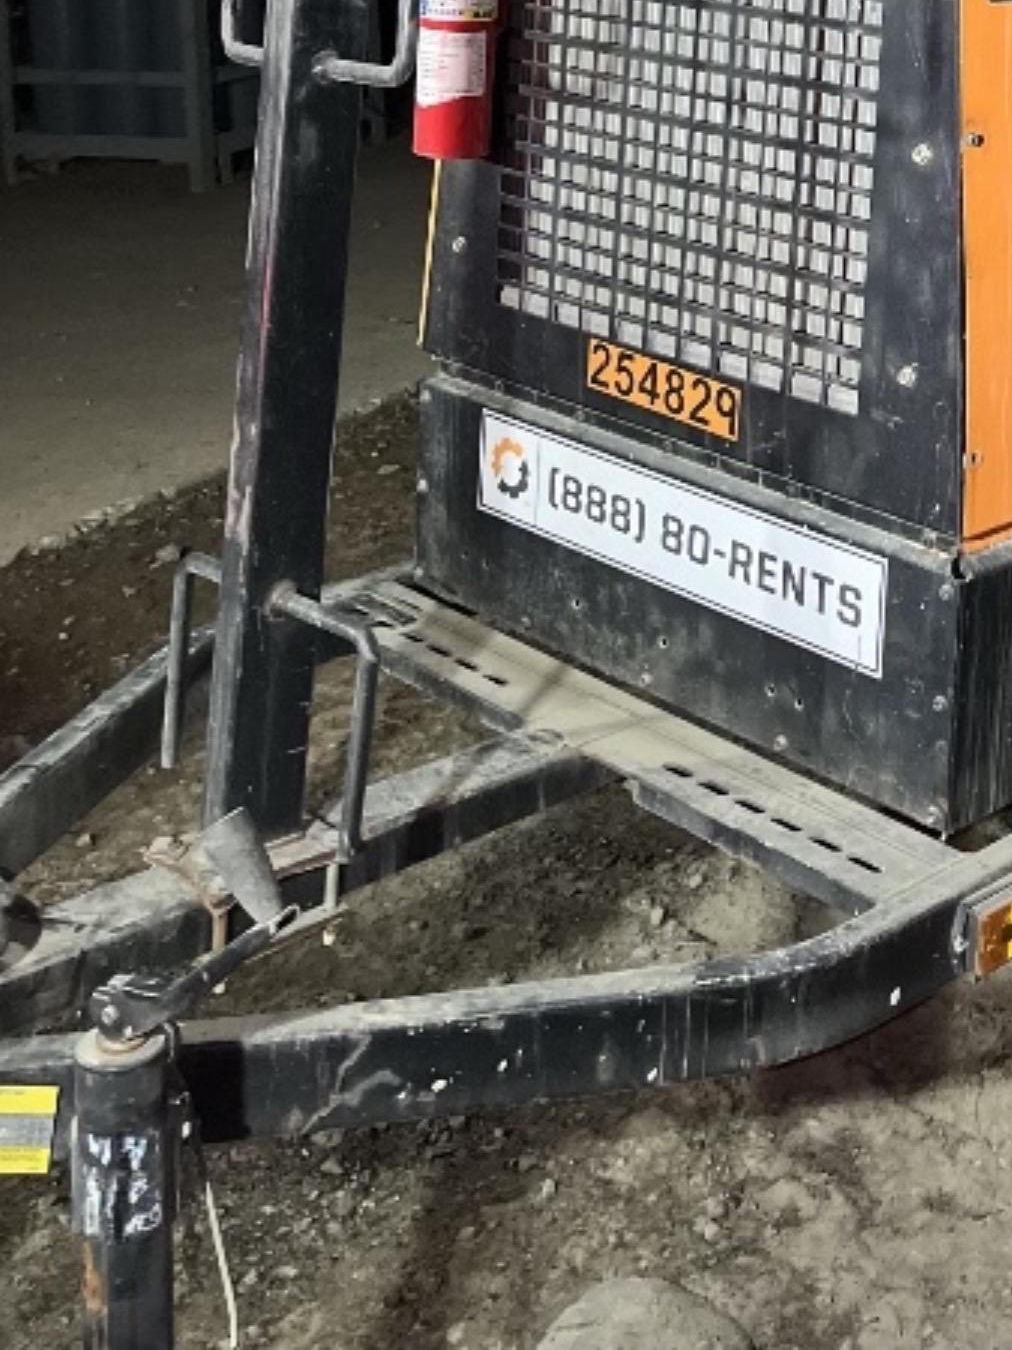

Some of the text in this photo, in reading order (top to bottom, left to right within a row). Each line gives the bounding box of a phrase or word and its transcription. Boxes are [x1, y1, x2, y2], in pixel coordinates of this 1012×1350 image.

[588, 342, 741, 435] 254829
[548, 466, 863, 629] (888) 80-RENTS
